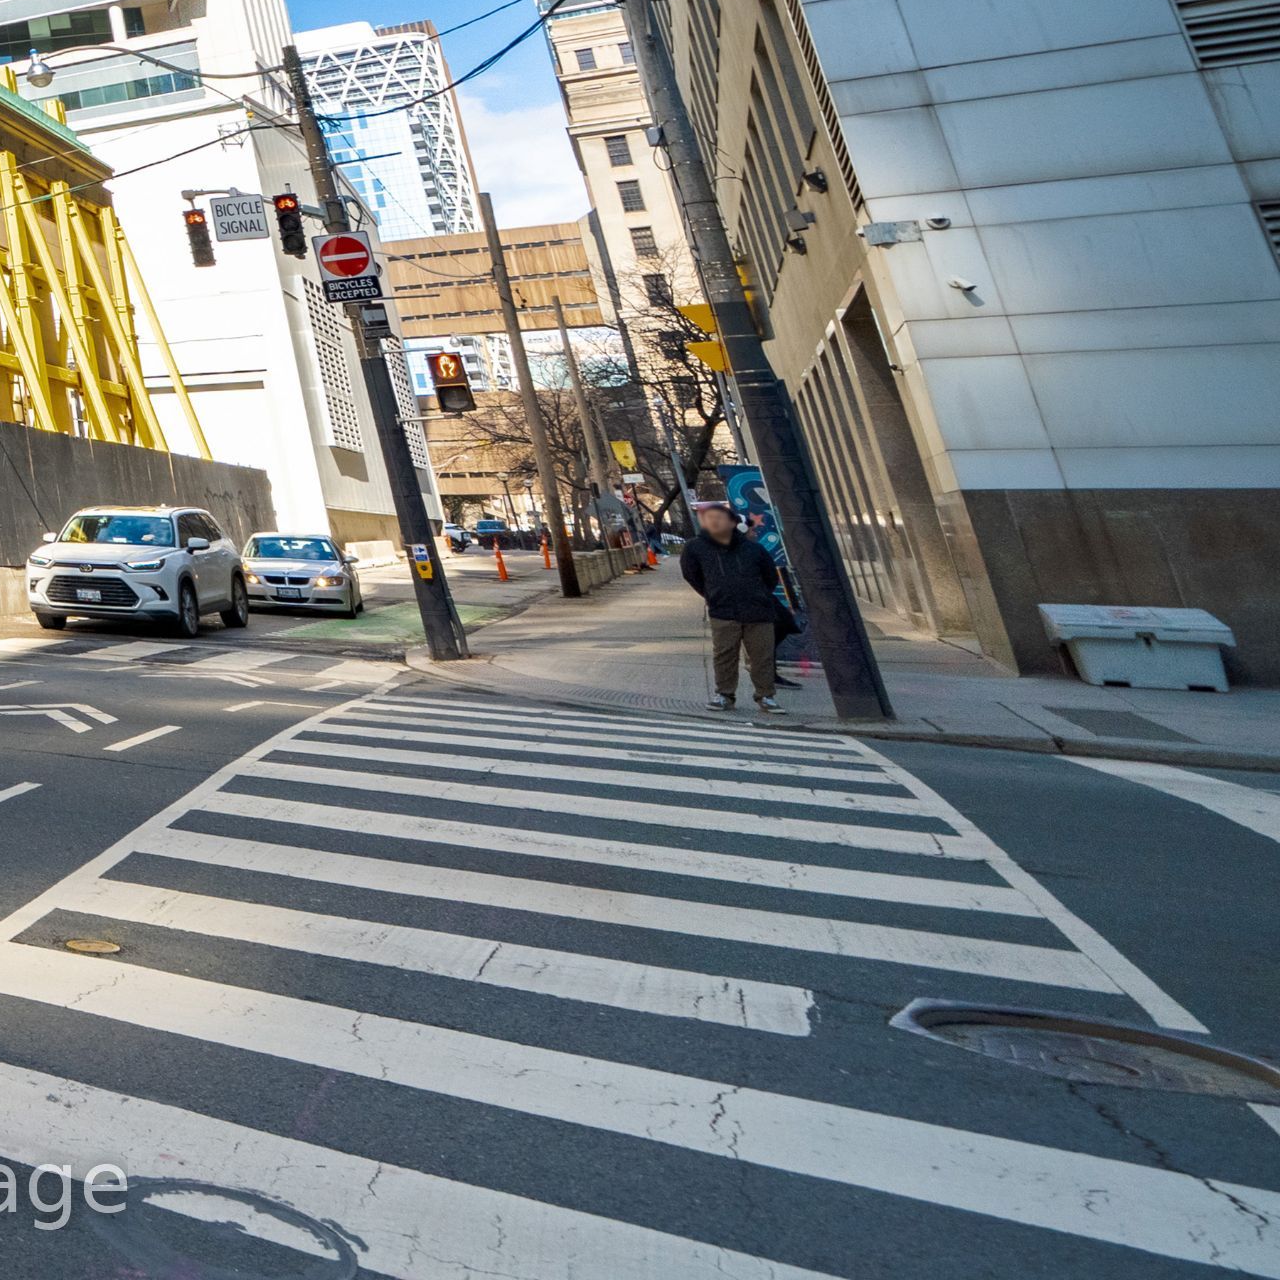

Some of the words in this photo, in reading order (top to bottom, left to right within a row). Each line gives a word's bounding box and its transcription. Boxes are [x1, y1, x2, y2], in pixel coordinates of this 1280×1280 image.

[215, 201, 263, 217] BICYCLE
[221, 219, 265, 235] SIGNAL
[328, 278, 374, 291] BICYCLES
[329, 288, 379, 301] EXCEPTED
